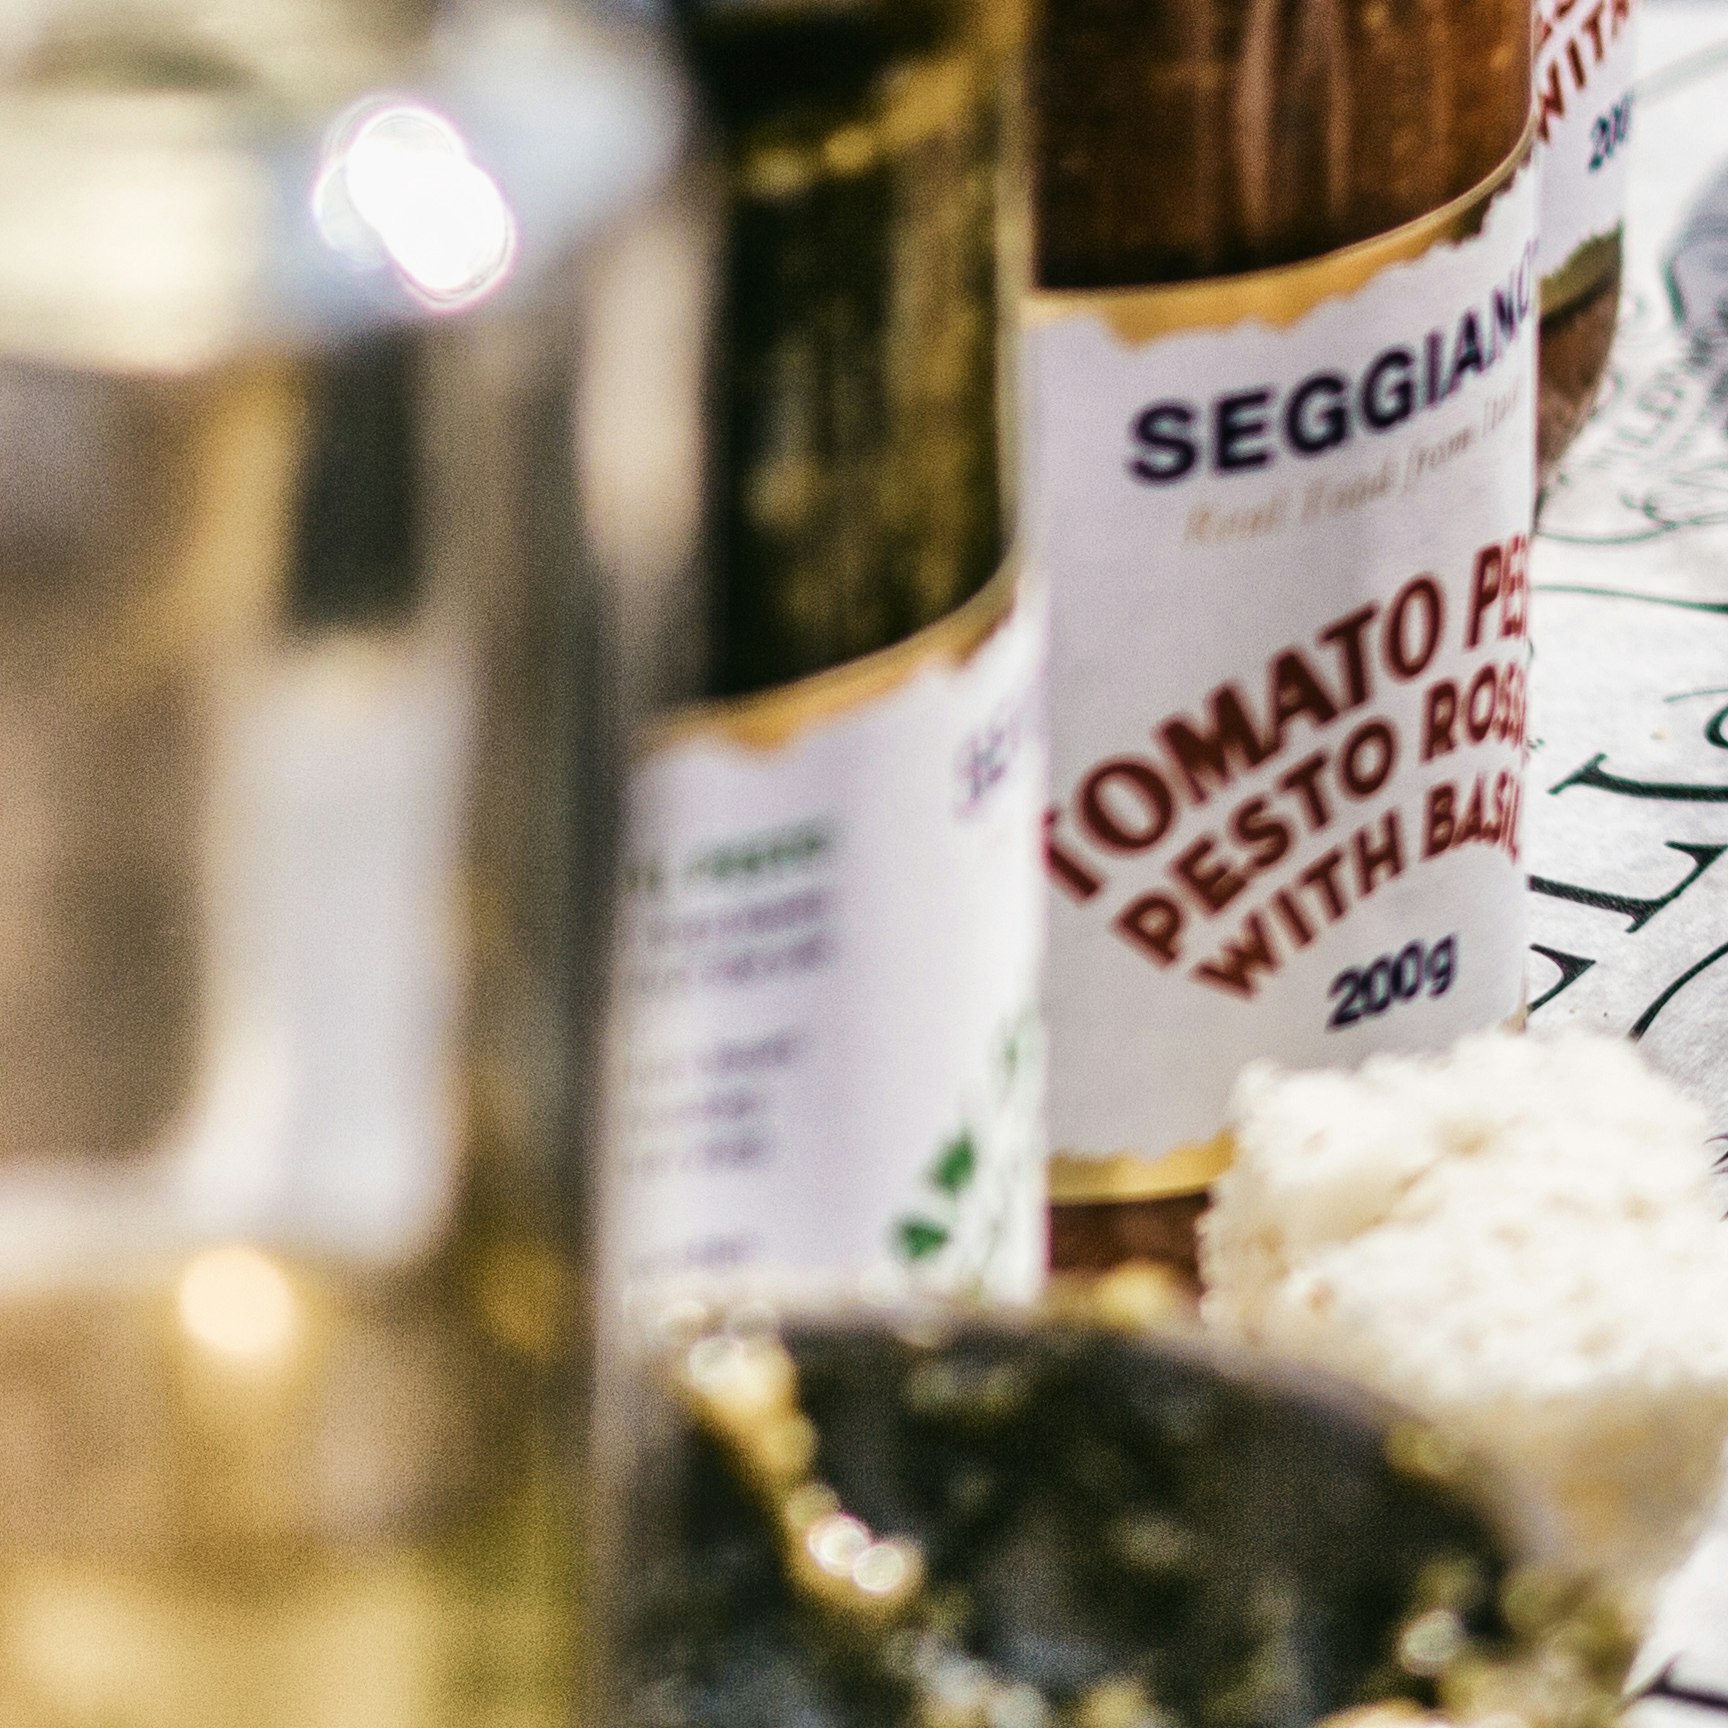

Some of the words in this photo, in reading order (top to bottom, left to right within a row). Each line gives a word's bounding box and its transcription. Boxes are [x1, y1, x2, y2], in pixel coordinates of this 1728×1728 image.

[1112, 716, 1398, 969] PESTO
[1193, 808, 1405, 998] WITH
[1326, 932, 1458, 1032] 200g
